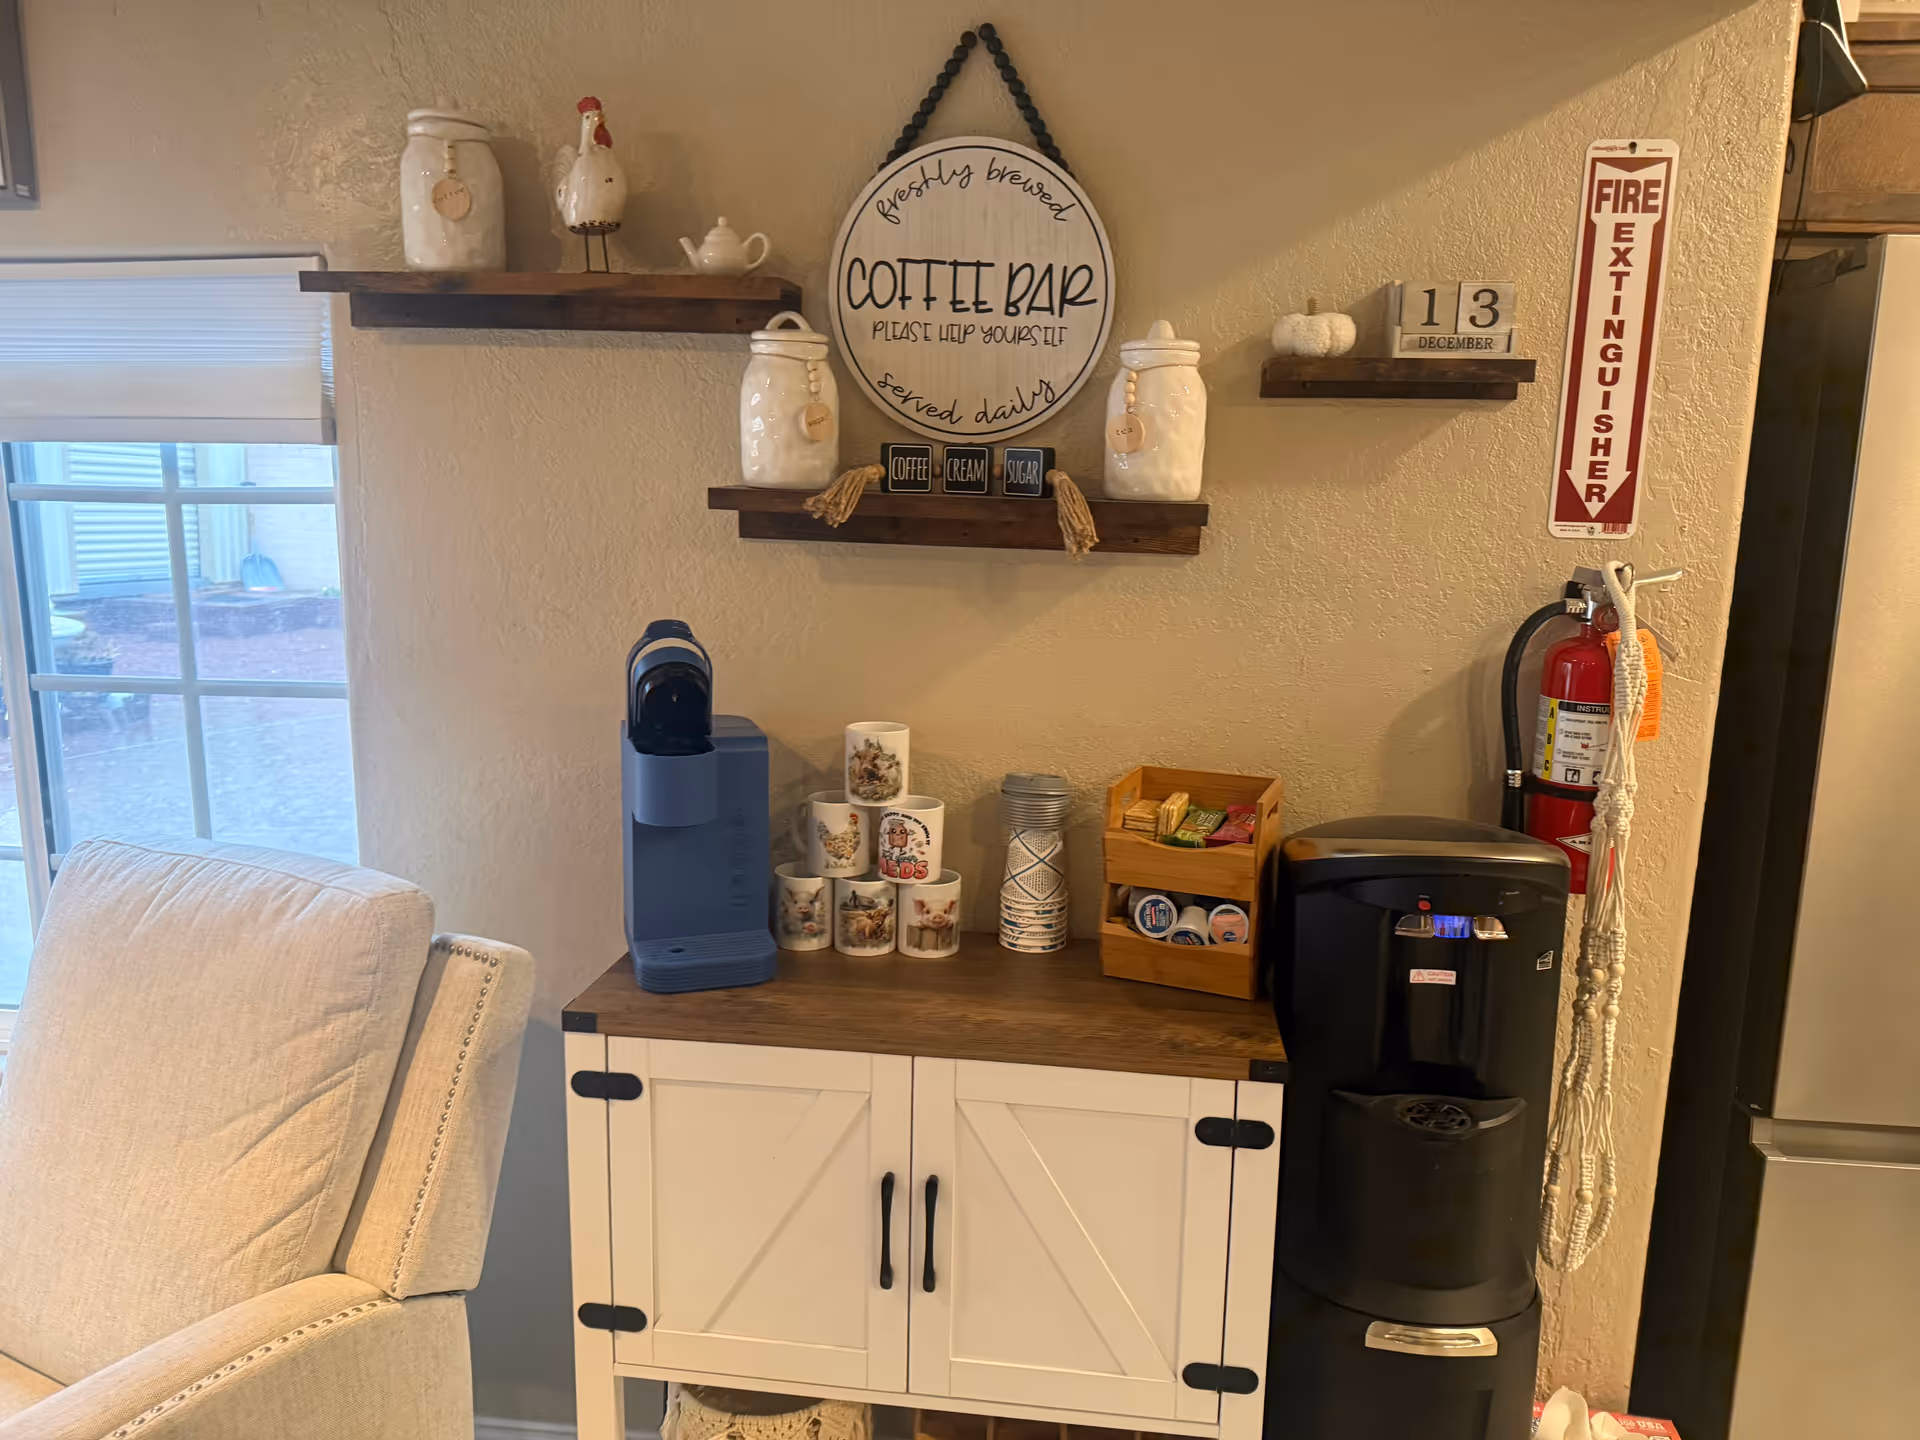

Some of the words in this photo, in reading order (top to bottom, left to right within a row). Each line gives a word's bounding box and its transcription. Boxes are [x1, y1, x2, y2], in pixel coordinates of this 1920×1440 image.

[986, 157, 1076, 222] brewed
[1594, 178, 1662, 214] FIRE
[847, 257, 995, 313] COFFEE
[1004, 262, 1098, 318] BAR
[1468, 288, 1500, 328] 3
[872, 321, 932, 343] PLEASE
[939, 323, 976, 344] HELP
[980, 324, 1068, 347] YOURSELF
[1418, 336, 1494, 350] DECEMBER
[1584, 222, 1636, 503] EXTINGUISHER
[877, 372, 963, 424] served
[974, 378, 1055, 424] daily
[892, 456, 928, 481] COFFEE
[947, 458, 985, 482] CREAM
[1007, 460, 1039, 485] SUGAR
[1576, 704, 1611, 714] INSTRUC
